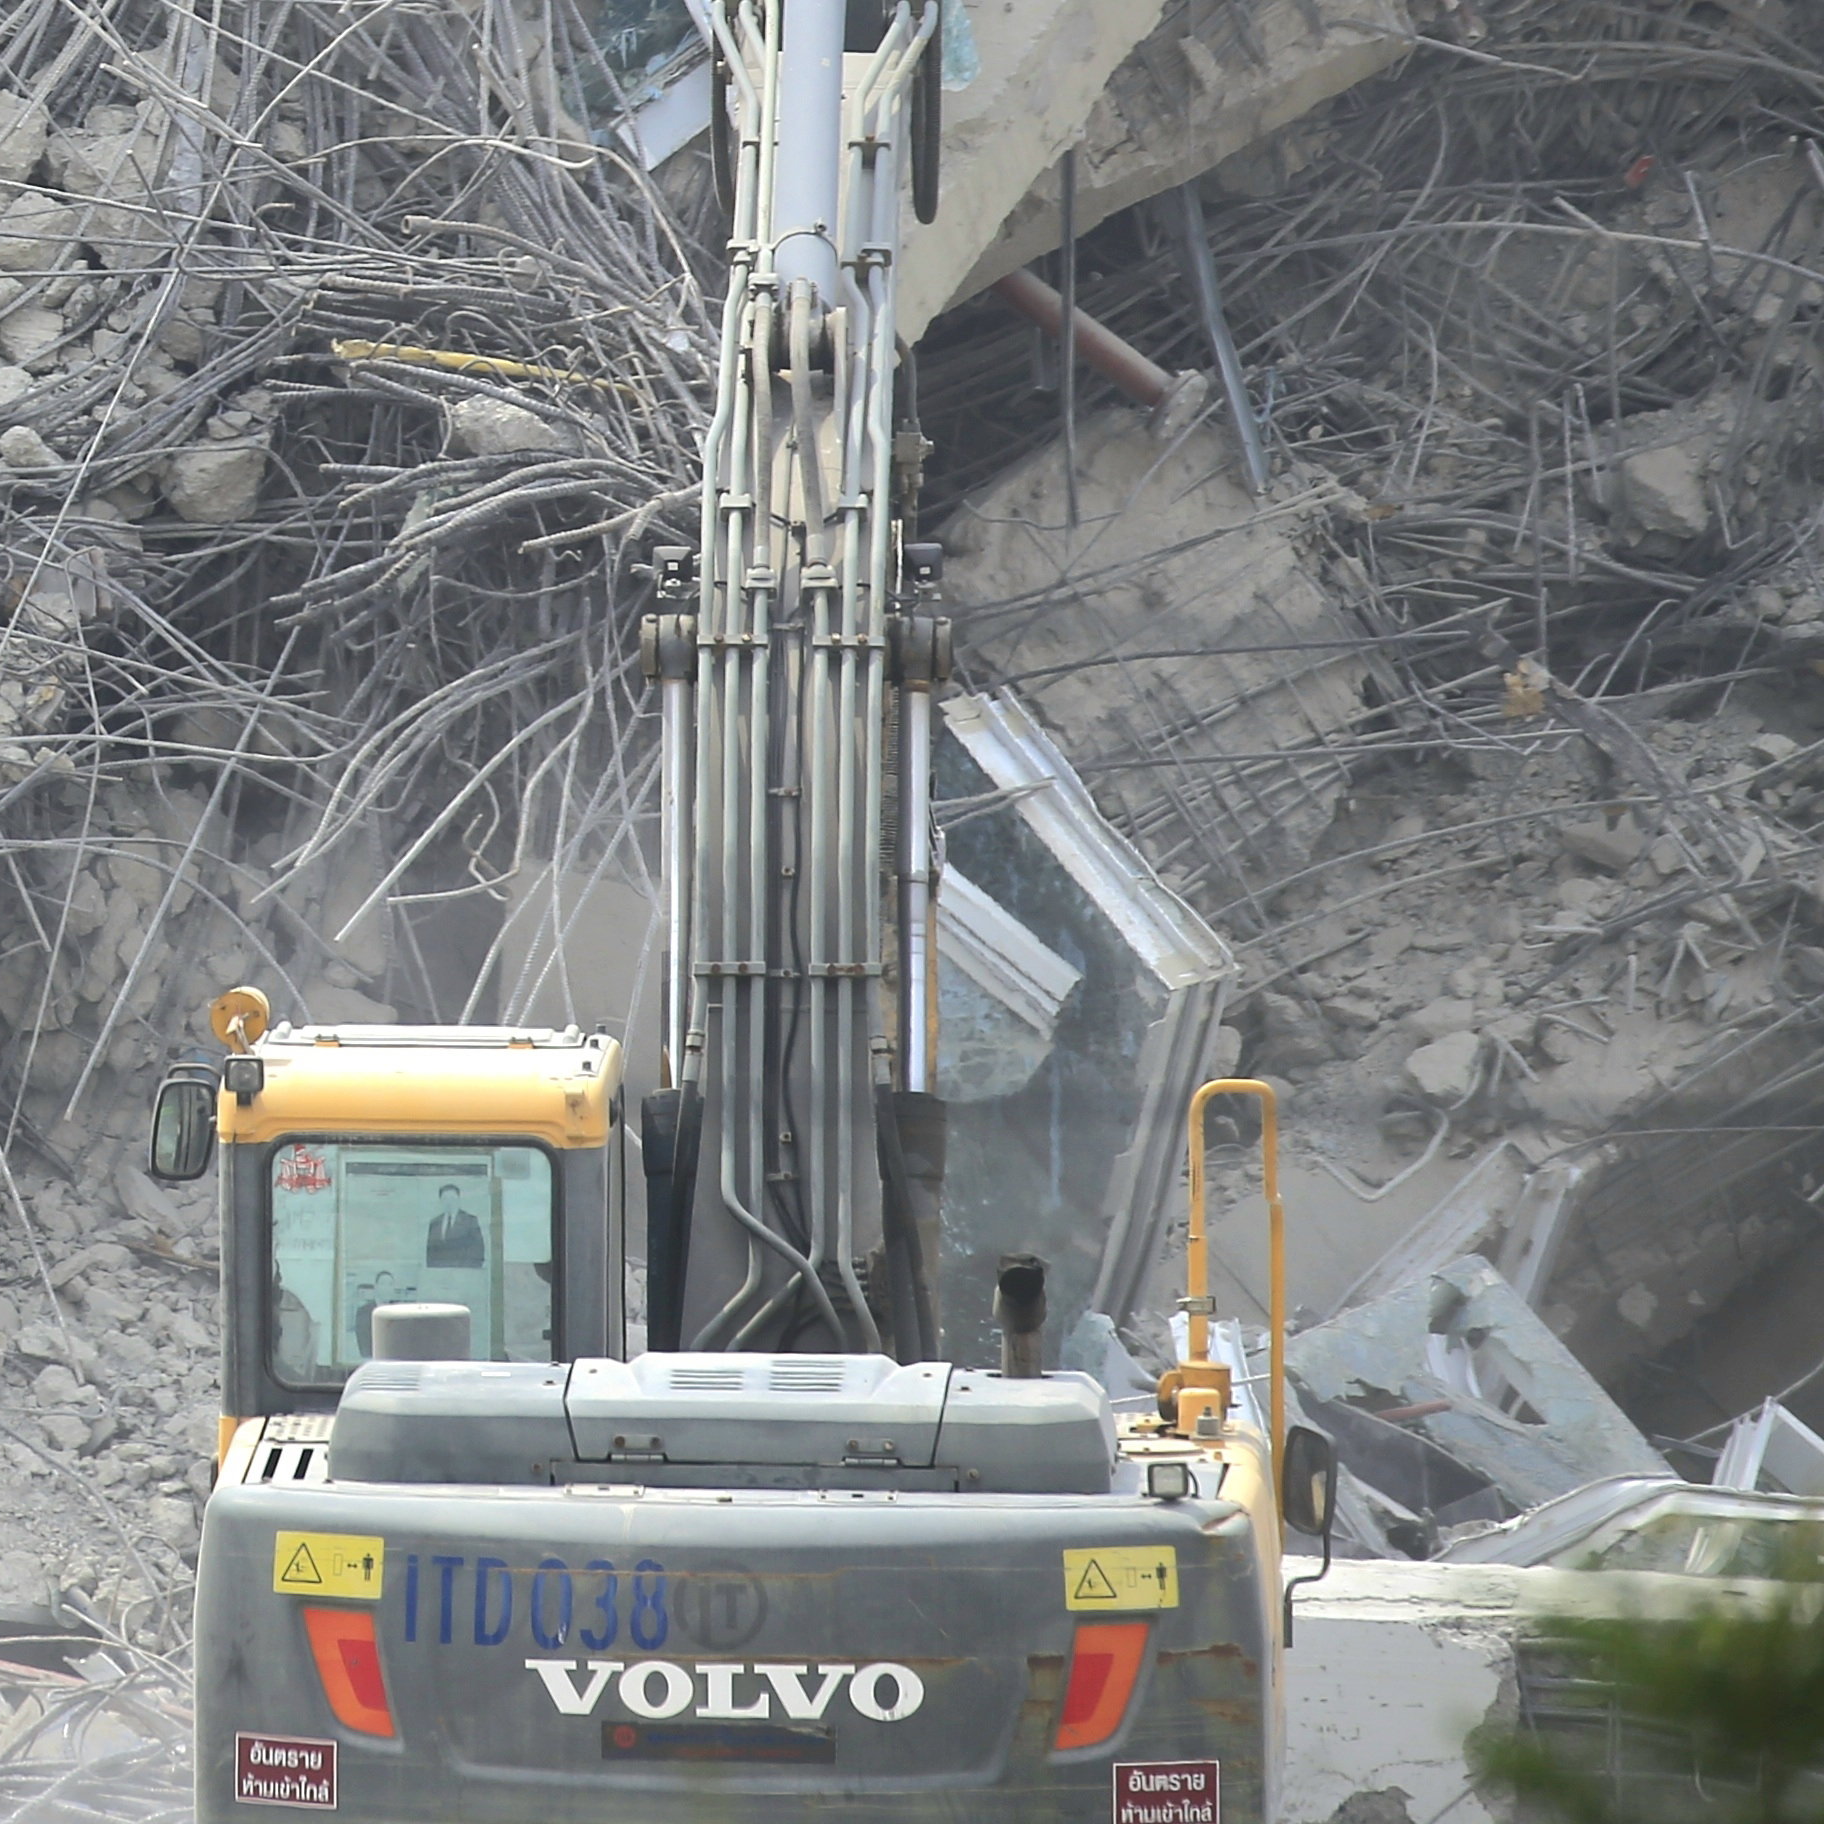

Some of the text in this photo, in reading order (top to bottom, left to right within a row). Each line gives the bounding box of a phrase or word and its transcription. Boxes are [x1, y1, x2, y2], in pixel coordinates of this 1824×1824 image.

[525, 1659, 925, 1722] VOLVO
[250, 1740, 322, 1771] อันตราย
[242, 1772, 330, 1803] ห้ามเข้าใกล้
[1128, 1769, 1206, 1792] อันตราย
[1121, 1798, 1214, 1824] ห้ามเข้าใกล้
